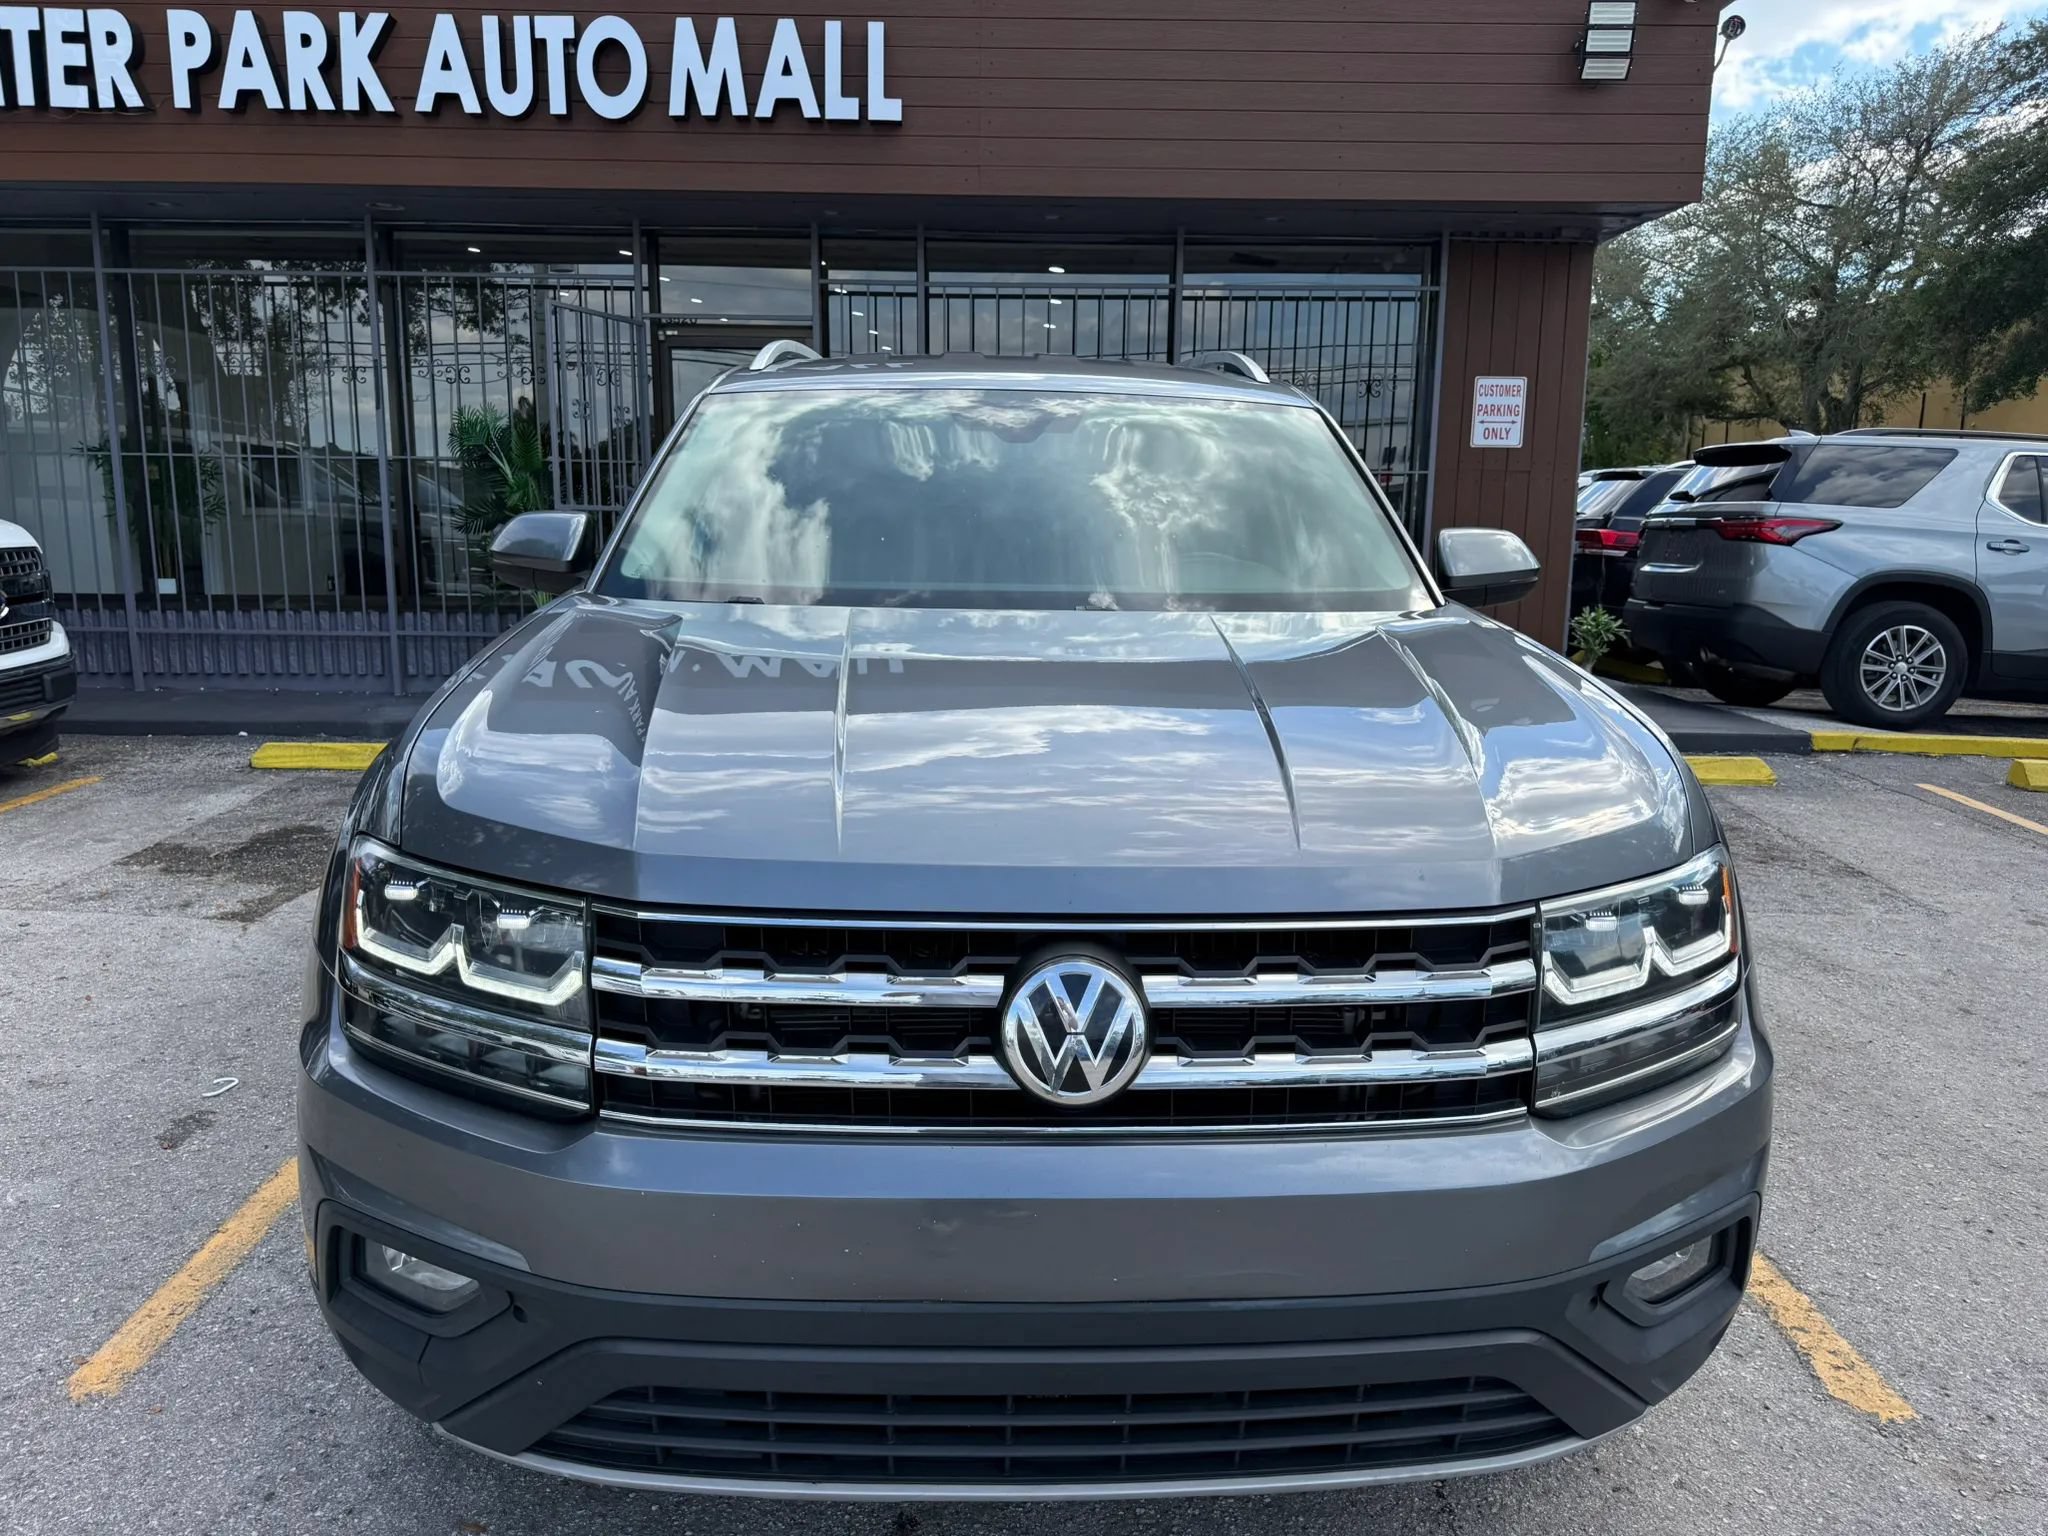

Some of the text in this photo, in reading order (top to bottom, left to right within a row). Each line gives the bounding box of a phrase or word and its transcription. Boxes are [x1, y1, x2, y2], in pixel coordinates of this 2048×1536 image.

[0, 5, 903, 121] TER PARK AUTO MALL
[1478, 384, 1522, 397] CUSTOMER
[1476, 404, 1520, 417] PARKING
[1483, 427, 1512, 440] ONLY
[1007, 959, 1143, 1103] VW
